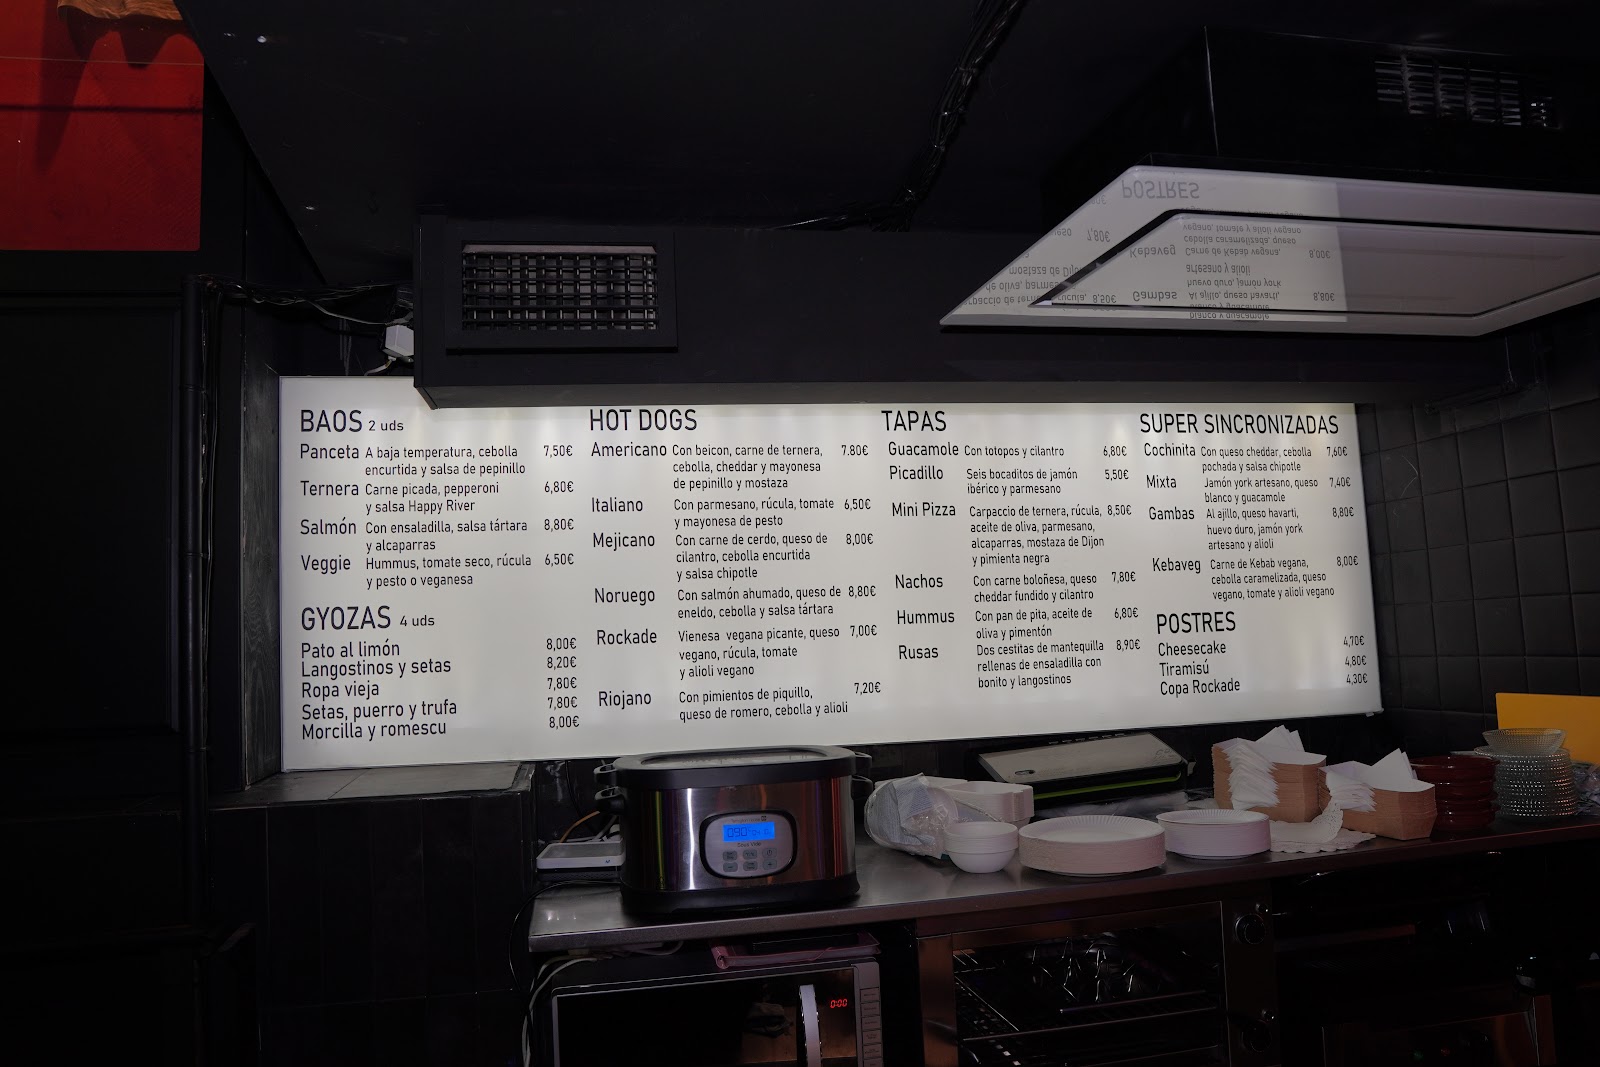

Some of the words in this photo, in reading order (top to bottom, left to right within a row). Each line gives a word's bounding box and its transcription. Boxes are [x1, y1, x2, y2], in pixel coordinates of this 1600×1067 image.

[301, 409, 363, 433] BAOS
[380, 420, 404, 431] uds
[590, 409, 632, 431] HOT
[639, 408, 697, 431] DOGS
[881, 410, 947, 432] TAPAS
[1140, 413, 1199, 434] SUPER
[1204, 413, 1339, 434] SINCRONIZADAS
[300, 443, 359, 459] Panceta
[403, 446, 475, 461] temperatura,
[543, 444, 573, 458] 7,50€
[591, 441, 667, 457] Americano
[695, 444, 732, 457] beicon,
[782, 445, 823, 457] ternera,
[888, 441, 959, 456] Guacamole
[985, 446, 1020, 459] totopos
[1103, 445, 1127, 458] 6,80€
[1144, 442, 1196, 457] Cochinita
[1246, 446, 1281, 458] cheddar,
[1326, 446, 1348, 458] 7,60€
[479, 462, 526, 477] pepinillo
[889, 465, 944, 480] Picadillo
[966, 468, 987, 480] Seis
[989, 468, 1034, 480] bocaditos
[1104, 469, 1129, 481] 5,50€
[1202, 461, 1237, 474] pochada
[300, 480, 359, 496] Ternera
[544, 480, 574, 495] 6,80€
[745, 477, 788, 488] mostaza
[1146, 474, 1177, 489] Mixta
[1204, 476, 1232, 488] Jamón
[1254, 478, 1293, 488] artesano,
[1329, 476, 1351, 488] 7,40€
[365, 483, 398, 496] Carne
[402, 482, 441, 498] picada,
[444, 481, 499, 497] pepperoni
[967, 482, 999, 494] ibérico
[1009, 485, 1061, 497] parmesano
[591, 496, 643, 513] Italiano
[844, 498, 871, 511] 6,50€
[1204, 492, 1232, 503] blanco
[1241, 491, 1286, 505] guacamole
[408, 500, 443, 515] Happy
[446, 499, 475, 511] River
[892, 502, 918, 517] Mini
[922, 501, 956, 516] Pizza
[969, 505, 1016, 520] Carpaccio
[1107, 504, 1132, 517] 8,50€
[1148, 506, 1195, 520] Gambas
[1217, 508, 1240, 521] ajillo,
[1268, 507, 1299, 519] havarti,
[1332, 506, 1354, 519] 8,80€
[300, 516, 356, 535] Salmón
[390, 520, 454, 534] ensaladilla,
[489, 518, 527, 532] tártara
[544, 518, 574, 532] 8,80€
[683, 517, 736, 530] mayonesa
[970, 521, 998, 533] aceite
[1015, 521, 1039, 533] oliva,
[1234, 524, 1256, 535] duro,
[375, 539, 436, 554] alcaparras
[593, 532, 655, 552] Mejicano
[747, 533, 779, 546] cerdo,
[846, 533, 874, 546] 8,00€
[1081, 535, 1104, 549] Dijon
[366, 557, 419, 570] Hummus,
[422, 556, 461, 568] tomate
[464, 557, 493, 568] seco,
[497, 553, 531, 566] rúcula
[544, 553, 574, 567] 6,50€
[676, 551, 719, 564] cilantro,
[722, 549, 759, 562] cebolla
[762, 548, 810, 561] encurtida
[980, 552, 1020, 567] pimienta
[1336, 555, 1359, 568] 8,00€
[301, 554, 351, 575] Veggie
[1152, 557, 1201, 574] Kebaveg
[1210, 559, 1235, 570] Carne
[1249, 558, 1275, 569] Kebab
[717, 566, 758, 581] chipotle
[895, 573, 943, 589] Nachos
[1023, 573, 1068, 586] boloñesa,
[1111, 571, 1136, 584] 7,80€
[1243, 572, 1301, 584] caramelizada,
[420, 575, 473, 589] veganesa
[594, 587, 655, 606] Noruego
[701, 586, 739, 601] salmón
[742, 587, 793, 600] ahumado,
[848, 585, 876, 599] 8,80€
[1015, 589, 1049, 601] fundido
[301, 605, 391, 631] GYOZAS
[678, 606, 716, 619] eneldo,
[897, 609, 955, 625] Hummus
[1030, 608, 1049, 623] pita,
[1114, 607, 1139, 620] 6,80€
[412, 614, 435, 627] uds
[1156, 611, 1236, 635] POSTRES
[597, 628, 657, 645] Rockade
[678, 630, 720, 642] Vienesa
[726, 631, 763, 643] vegana
[766, 627, 806, 642] picante,
[850, 624, 878, 638] 7,00€
[1009, 624, 1052, 641] pimentón
[546, 637, 577, 652] 8,00€
[997, 643, 1034, 655] cestitas
[1050, 639, 1104, 654] mantequilla
[1116, 638, 1141, 652] 8,90€
[1158, 640, 1226, 657] Cheesecake
[1343, 635, 1365, 648] 4,70€
[301, 642, 335, 659] Pato
[679, 650, 720, 663] vegano,
[898, 644, 939, 660] Rusas
[547, 656, 577, 671] 8,20€
[977, 660, 1016, 672] rellenas
[1159, 658, 1209, 677] Tiramisú
[1345, 655, 1367, 668] 4,80€
[301, 659, 394, 681] Langostinos
[547, 676, 577, 691] 7,80€
[978, 676, 1007, 688] bonito
[1018, 673, 1072, 689] langostinos
[1346, 673, 1368, 685] 4,30€
[302, 682, 339, 702] Ropa
[854, 681, 881, 695] 7,20€
[1160, 681, 1189, 698] Copa
[1192, 677, 1240, 694] Rockade
[598, 690, 652, 710] Riojano
[702, 689, 754, 705] pimientos
[773, 686, 813, 702] piquillo,
[547, 696, 578, 711] 7,80€
[730, 707, 772, 718] romero,
[775, 703, 812, 716] cebolla
[823, 701, 848, 714] alioli
[302, 704, 348, 721] Setas,
[353, 704, 404, 723] puerro
[549, 715, 580, 730] 8,00€
[302, 722, 363, 740] Morcilla
[381, 722, 446, 737] romescu
[830, 998, 848, 1009] 0:00
